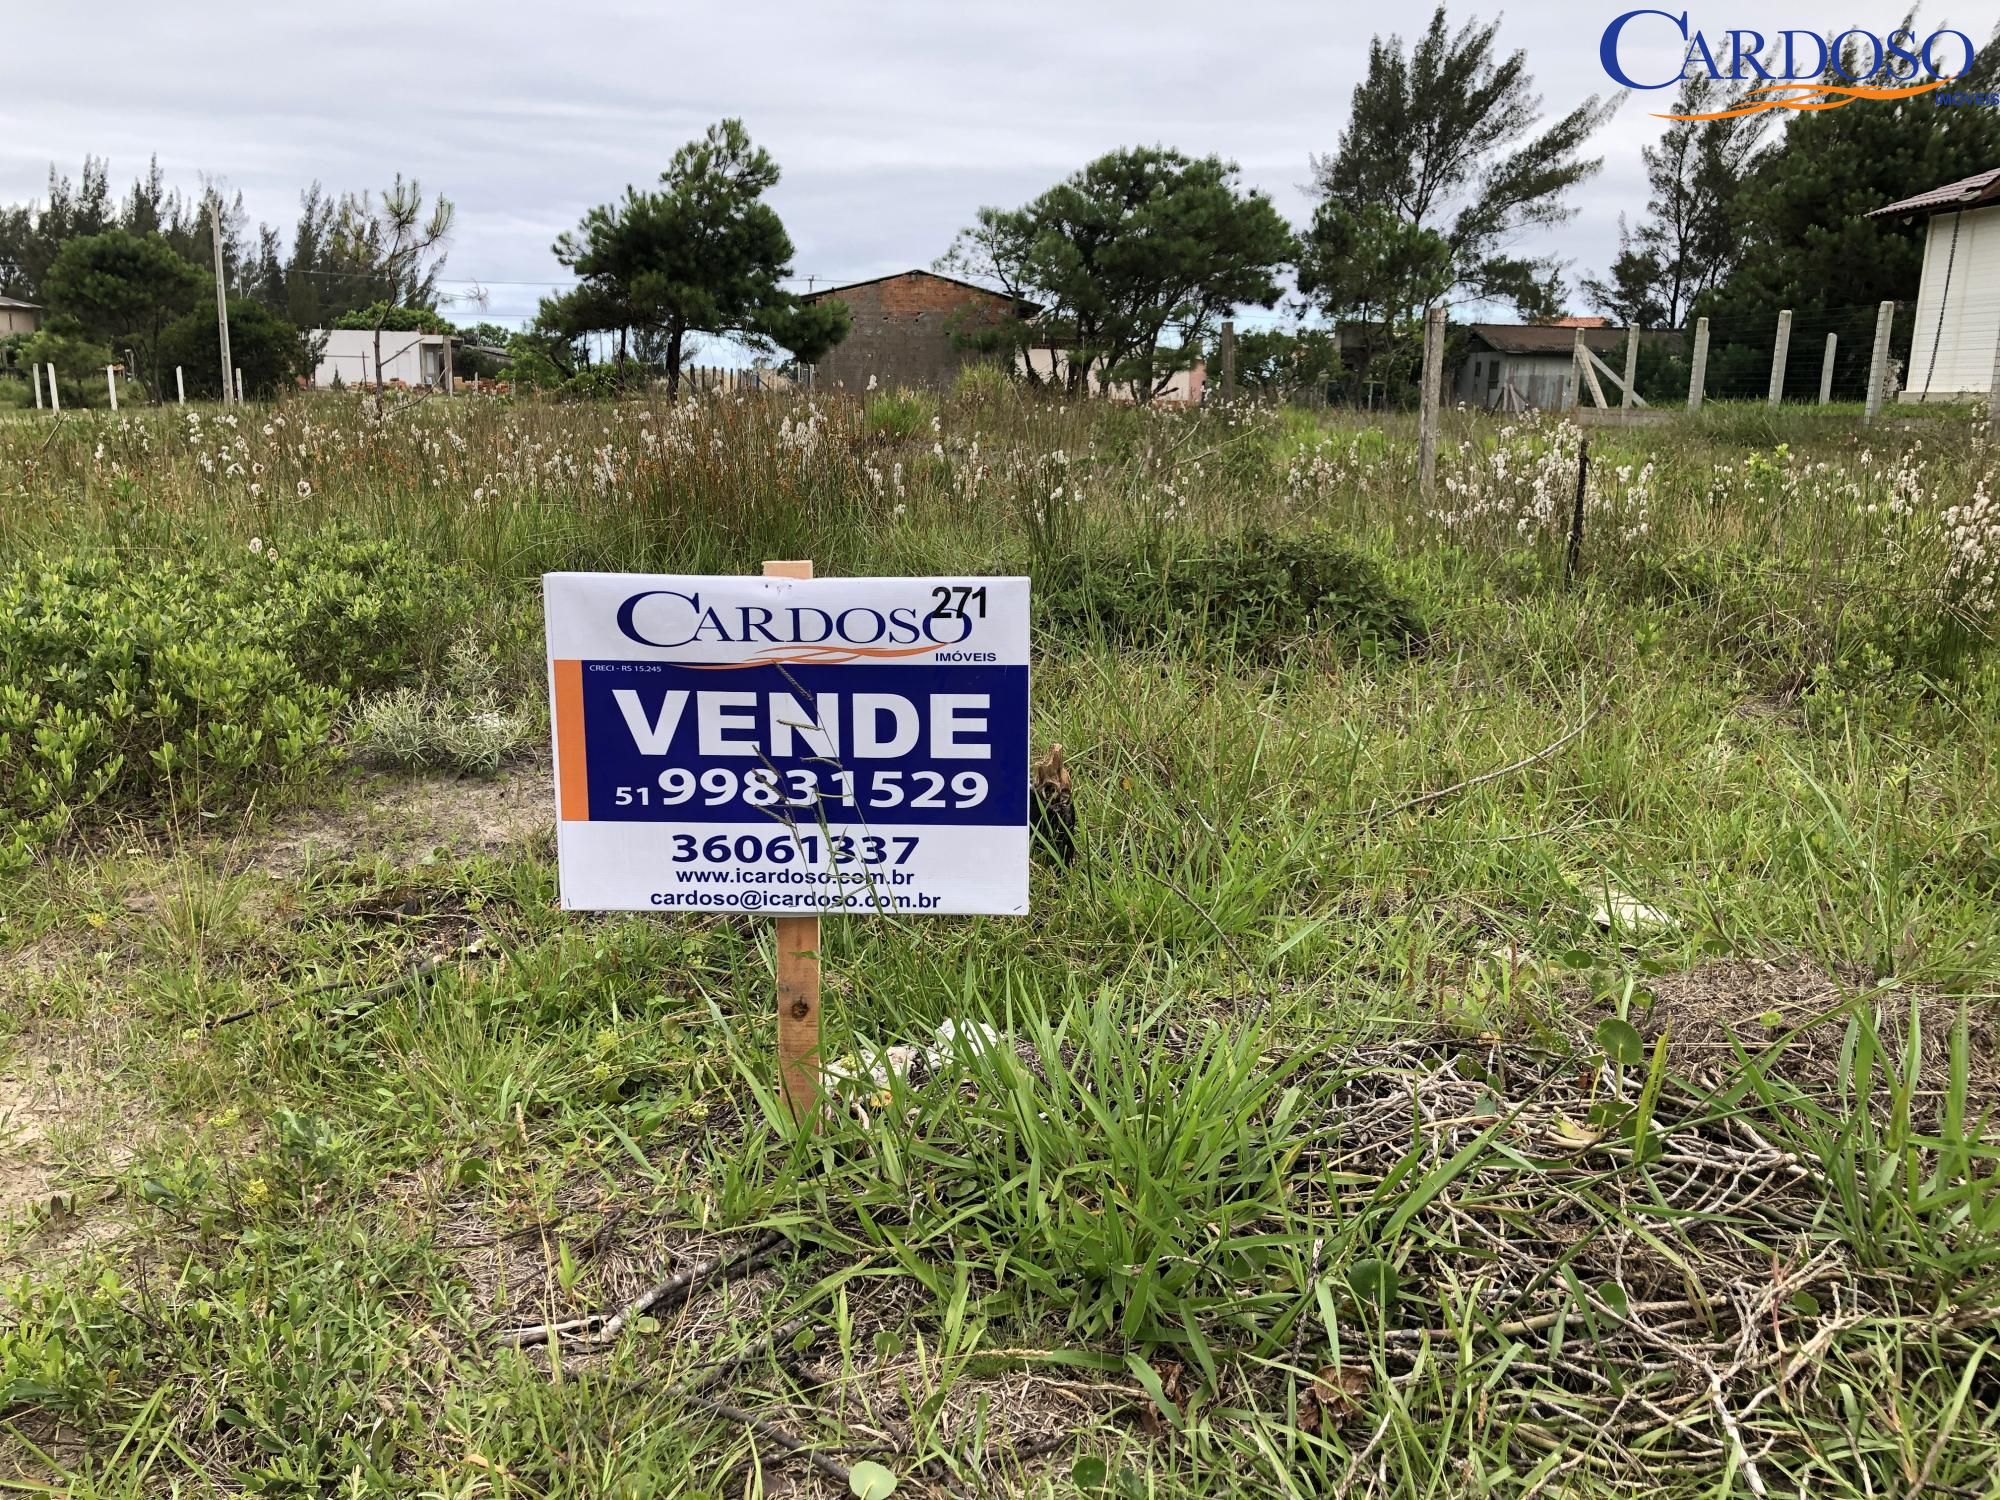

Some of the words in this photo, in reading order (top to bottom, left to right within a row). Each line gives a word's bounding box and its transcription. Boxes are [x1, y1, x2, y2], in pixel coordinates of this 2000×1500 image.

[931, 586, 987, 619] 271
[616, 590, 973, 648] CARDOSO
[589, 664, 614, 672] CRECI
[935, 650, 997, 662] IMÓVEIS
[612, 689, 993, 760] VENDE
[615, 786, 649, 806] 51
[658, 767, 990, 809] 99831529
[671, 833, 920, 865] 36061337
[676, 868, 915, 885] www.icardoso.com.br
[650, 890, 941, 910] cardoso@icardoso.com.br
